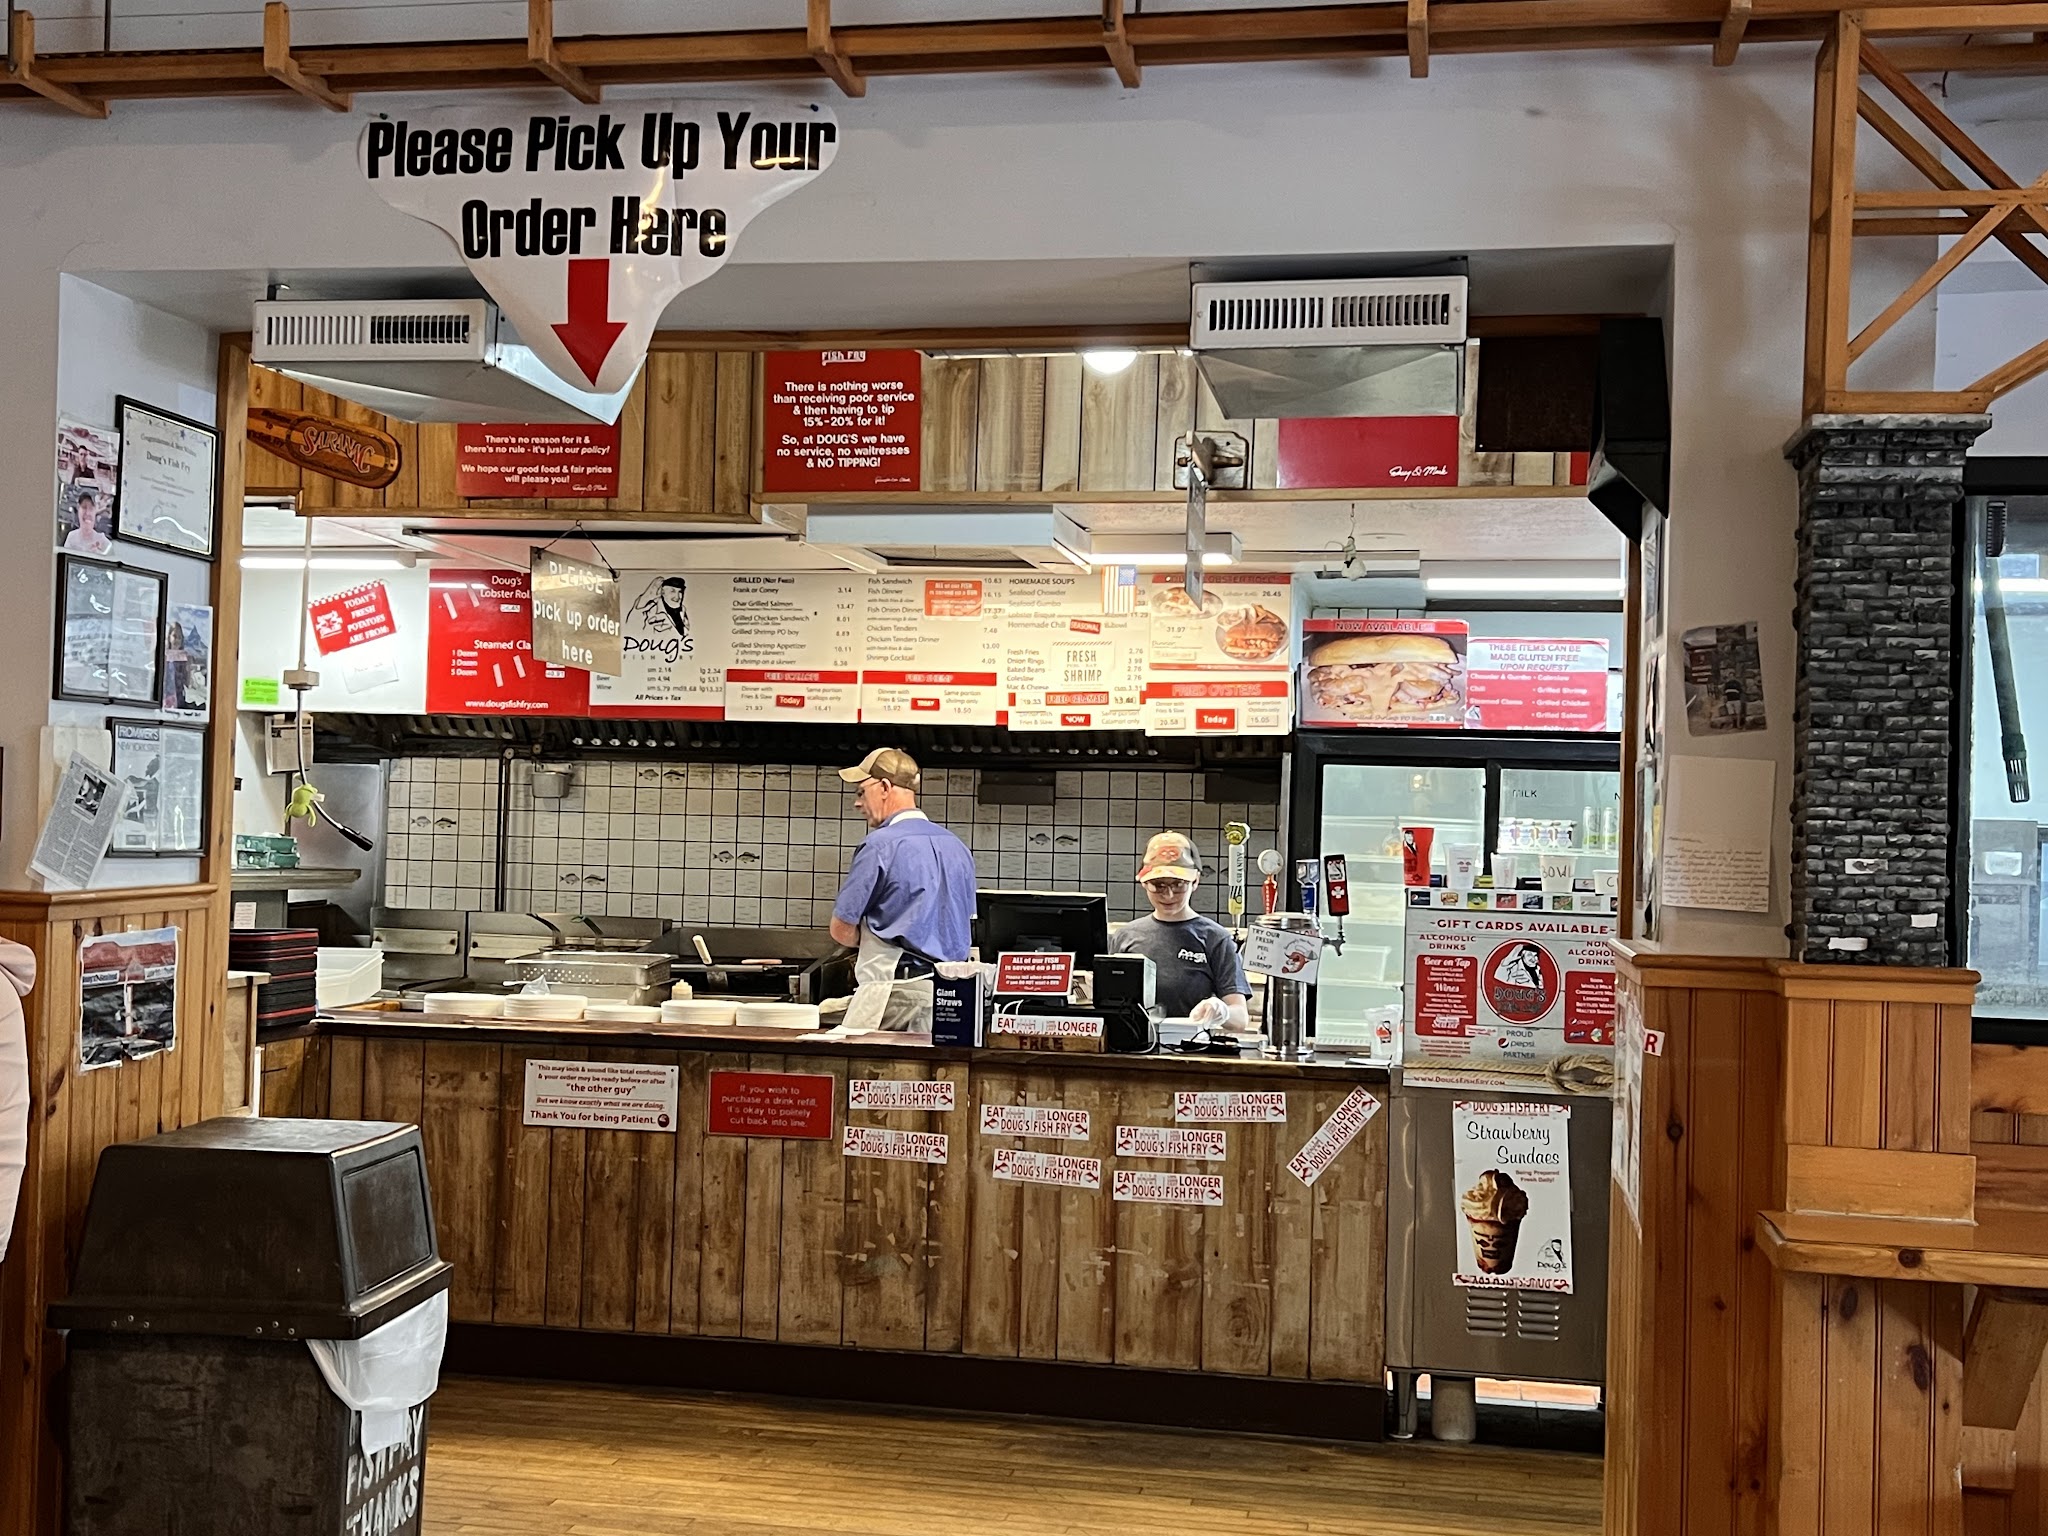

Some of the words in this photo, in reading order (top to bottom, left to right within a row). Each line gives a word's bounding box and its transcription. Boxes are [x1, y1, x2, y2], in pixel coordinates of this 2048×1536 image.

[367, 120, 513, 179] Please
[525, 114, 625, 171] Pick
[641, 112, 701, 179] Up
[717, 111, 837, 171] Your
[462, 197, 596, 259] Order
[610, 195, 727, 257] Here
[785, 381, 814, 392] There
[818, 381, 827, 392] is
[830, 380, 868, 393] nothing
[871, 381, 903, 391] worse
[773, 394, 796, 404] than
[799, 393, 846, 405] receiving
[849, 393, 874, 405] poor
[877, 392, 915, 402] service
[793, 405, 801, 415] &
[804, 405, 827, 415] then
[830, 404, 863, 416] having
[867, 404, 878, 414] to
[881, 403, 895, 415] tip
[857, 416, 872, 426] for
[875, 415, 886, 426] it!
[485, 435, 516, 444] There's
[518, 436, 530, 444] no
[531, 436, 560, 444] reason
[562, 435, 574, 444] for
[576, 435, 582, 444] it
[583, 435, 590, 444] &
[782, 435, 800, 446] So,
[802, 435, 813, 445] at
[816, 434, 858, 444] DOUG'S
[861, 435, 877, 444] we
[880, 433, 905, 443] have
[300, 426, 376, 474] SARANAC
[464, 445, 494, 454] there's
[508, 445, 525, 454] rule
[532, 445, 545, 454] it's
[547, 445, 563, 456] just
[564, 446, 579, 454] our
[580, 445, 610, 456] policy!
[776, 448, 790, 456] no
[794, 446, 834, 457] service,
[837, 447, 851, 456] no
[854, 445, 910, 456] waitresses
[806, 458, 814, 468] &
[817, 458, 834, 468] NO
[837, 457, 881, 467] TIPPING!
[461, 464, 475, 473] We
[477, 464, 499, 475] hope
[500, 465, 516, 473] our
[517, 465, 539, 475] good
[540, 465, 560, 473] food
[562, 465, 569, 473] &
[570, 465, 584, 473] fair
[586, 464, 613, 475] prices
[504, 475, 520, 483] will
[521, 475, 549, 485] please
[551, 475, 570, 485] you!
[491, 575, 522, 587] Doug's
[550, 560, 603, 595] PLEASE
[344, 591, 377, 609] TODAY'S
[480, 589, 513, 599] Lobster
[515, 589, 531, 599] Rol
[351, 605, 376, 619] FRESH
[533, 598, 561, 623] pick
[567, 608, 582, 632] up
[587, 612, 620, 637] order
[347, 614, 386, 632] POTATOES
[1335, 621, 1363, 632] NOW
[349, 632, 365, 644] ARE
[474, 640, 513, 650] Steamed
[516, 640, 531, 650] Cla
[623, 636, 694, 664] Doug's
[1489, 644, 1517, 652] THESE
[1519, 644, 1546, 652] ITEMS
[1548, 644, 1567, 652] CAN
[561, 639, 593, 665] here
[1066, 650, 1096, 662] FRESH
[1556, 654, 1579, 662] FREE
[1500, 663, 1525, 671] UPON
[1527, 663, 1570, 671] REQUEST
[1064, 669, 1102, 682] SHRIMP
[1172, 684, 1207, 697] FRIED
[1208, 684, 1262, 696] OYSTERS
[465, 700, 549, 710] www.dougsfishfry.com
[779, 696, 801, 706] Today
[1203, 715, 1228, 725] Today
[1541, 865, 1573, 879] BOWL
[1475, 921, 1524, 931] CARDS
[1252, 927, 1264, 936] TRY
[1266, 930, 1280, 938] OUR
[1419, 934, 1477, 942] ALCOHOLIC
[1429, 943, 1466, 951] DRINKS
[936, 987, 956, 997] Giant
[936, 997, 963, 1007] Straws
[1510, 1040, 1536, 1048] pepsi
[1503, 1051, 1536, 1059] PARTNER
[587, 1083, 613, 1093] other
[853, 1082, 871, 1092] EAT
[912, 1082, 951, 1093] LONGER
[868, 1093, 896, 1104] DOUG'S
[900, 1094, 919, 1105] FISH
[921, 1094, 937, 1105] FRY
[1179, 1093, 1198, 1104] EAT
[1241, 1094, 1283, 1104] LONGER
[530, 1110, 558, 1120] Thank
[560, 1111, 577, 1121] You
[578, 1112, 591, 1121] for
[593, 1112, 619, 1124] being
[621, 1114, 656, 1124] Patient.
[986, 1106, 1005, 1118] EAT
[1047, 1110, 1087, 1123] LONGER
[1194, 1105, 1224, 1117] DOUG'S
[1228, 1106, 1248, 1117] FISH
[1251, 1106, 1268, 1117] FRY
[1001, 1119, 1030, 1131] DOUG'S
[1033, 1121, 1053, 1133] FISH
[1056, 1122, 1072, 1134] FRY
[1290, 1152, 1308, 1172] EAT
[1332, 1089, 1366, 1126] LONGER
[1309, 1140, 1336, 1169] DOUG'S
[1332, 1122, 1353, 1145] FISH
[1347, 1108, 1365, 1127] FRY
[1466, 1120, 1550, 1146] Strawberry
[1496, 1145, 1560, 1165] Sundaes
